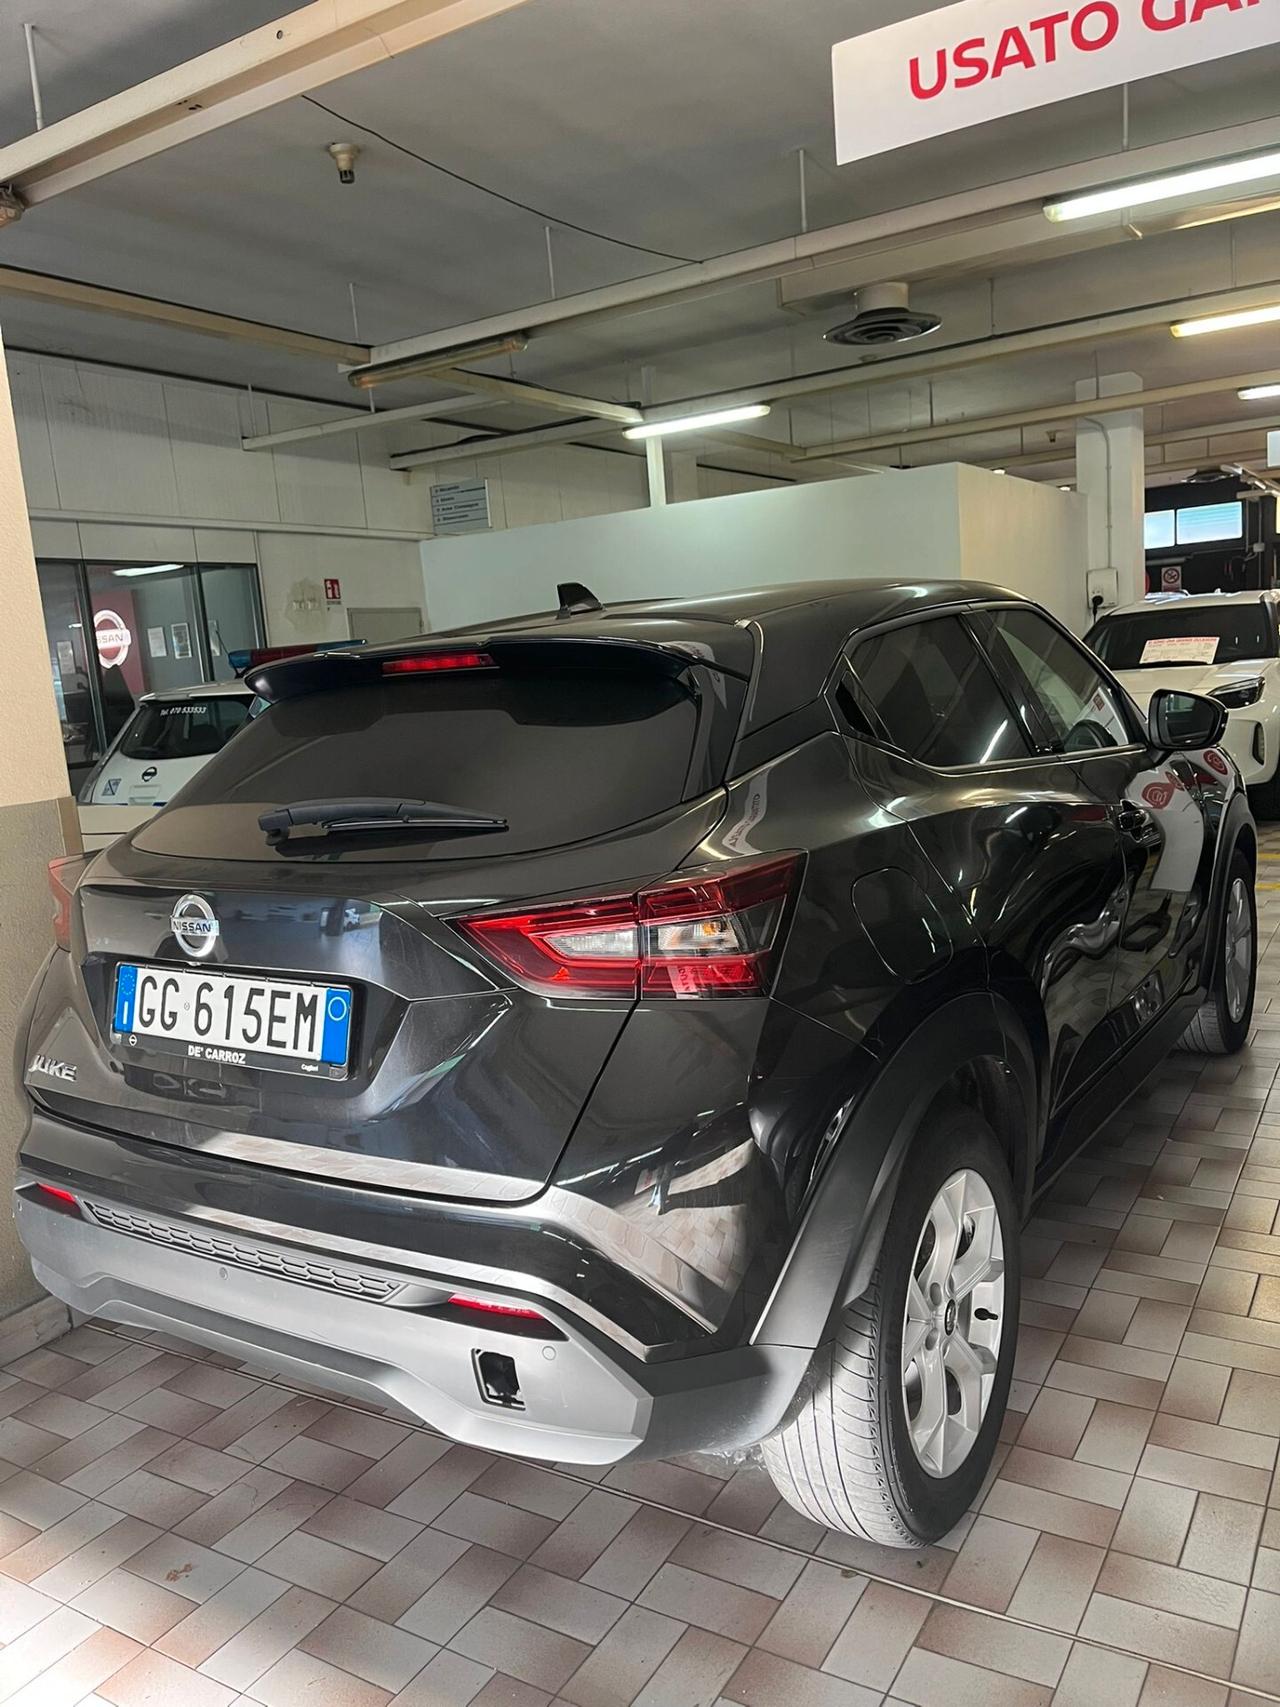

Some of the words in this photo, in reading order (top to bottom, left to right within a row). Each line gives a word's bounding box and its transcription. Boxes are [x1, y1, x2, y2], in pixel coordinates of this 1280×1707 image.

[909, 2, 1120, 100] USATO
[97, 633, 123, 644] SSAN
[173, 921, 211, 933] NISSAN
[139, 975, 180, 1031] GG
[194, 981, 318, 1053] 615EM
[188, 1045, 204, 1058] DE'
[205, 1047, 246, 1064] CARROZ
[28, 1055, 77, 1082] JUKE
